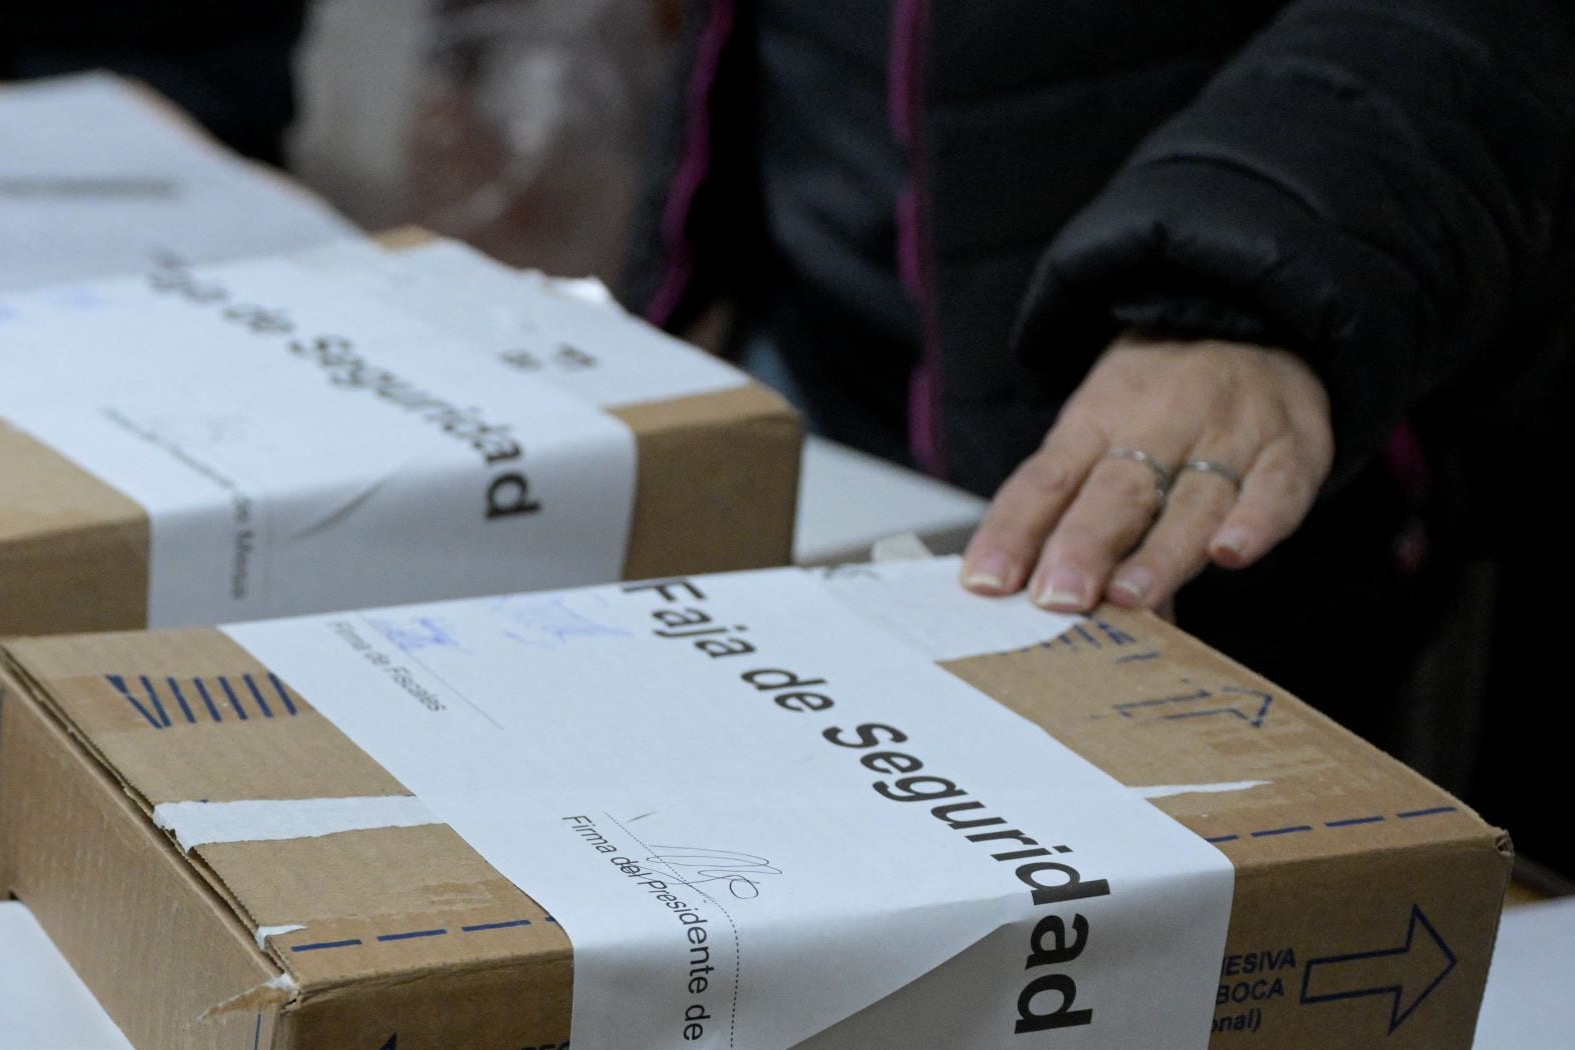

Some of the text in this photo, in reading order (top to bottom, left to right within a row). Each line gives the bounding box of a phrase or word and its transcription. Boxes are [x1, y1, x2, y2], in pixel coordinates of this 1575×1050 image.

[287, 334, 542, 521] Seguridad
[382, 666, 447, 711] Fiscales
[623, 579, 1112, 1036] Faja de Seguridad
[561, 814, 618, 854] Firma
[610, 856, 648, 880] del
[636, 878, 715, 995] Presidente
[684, 1003, 711, 1041] de
[1216, 976, 1286, 1005] BOCA
